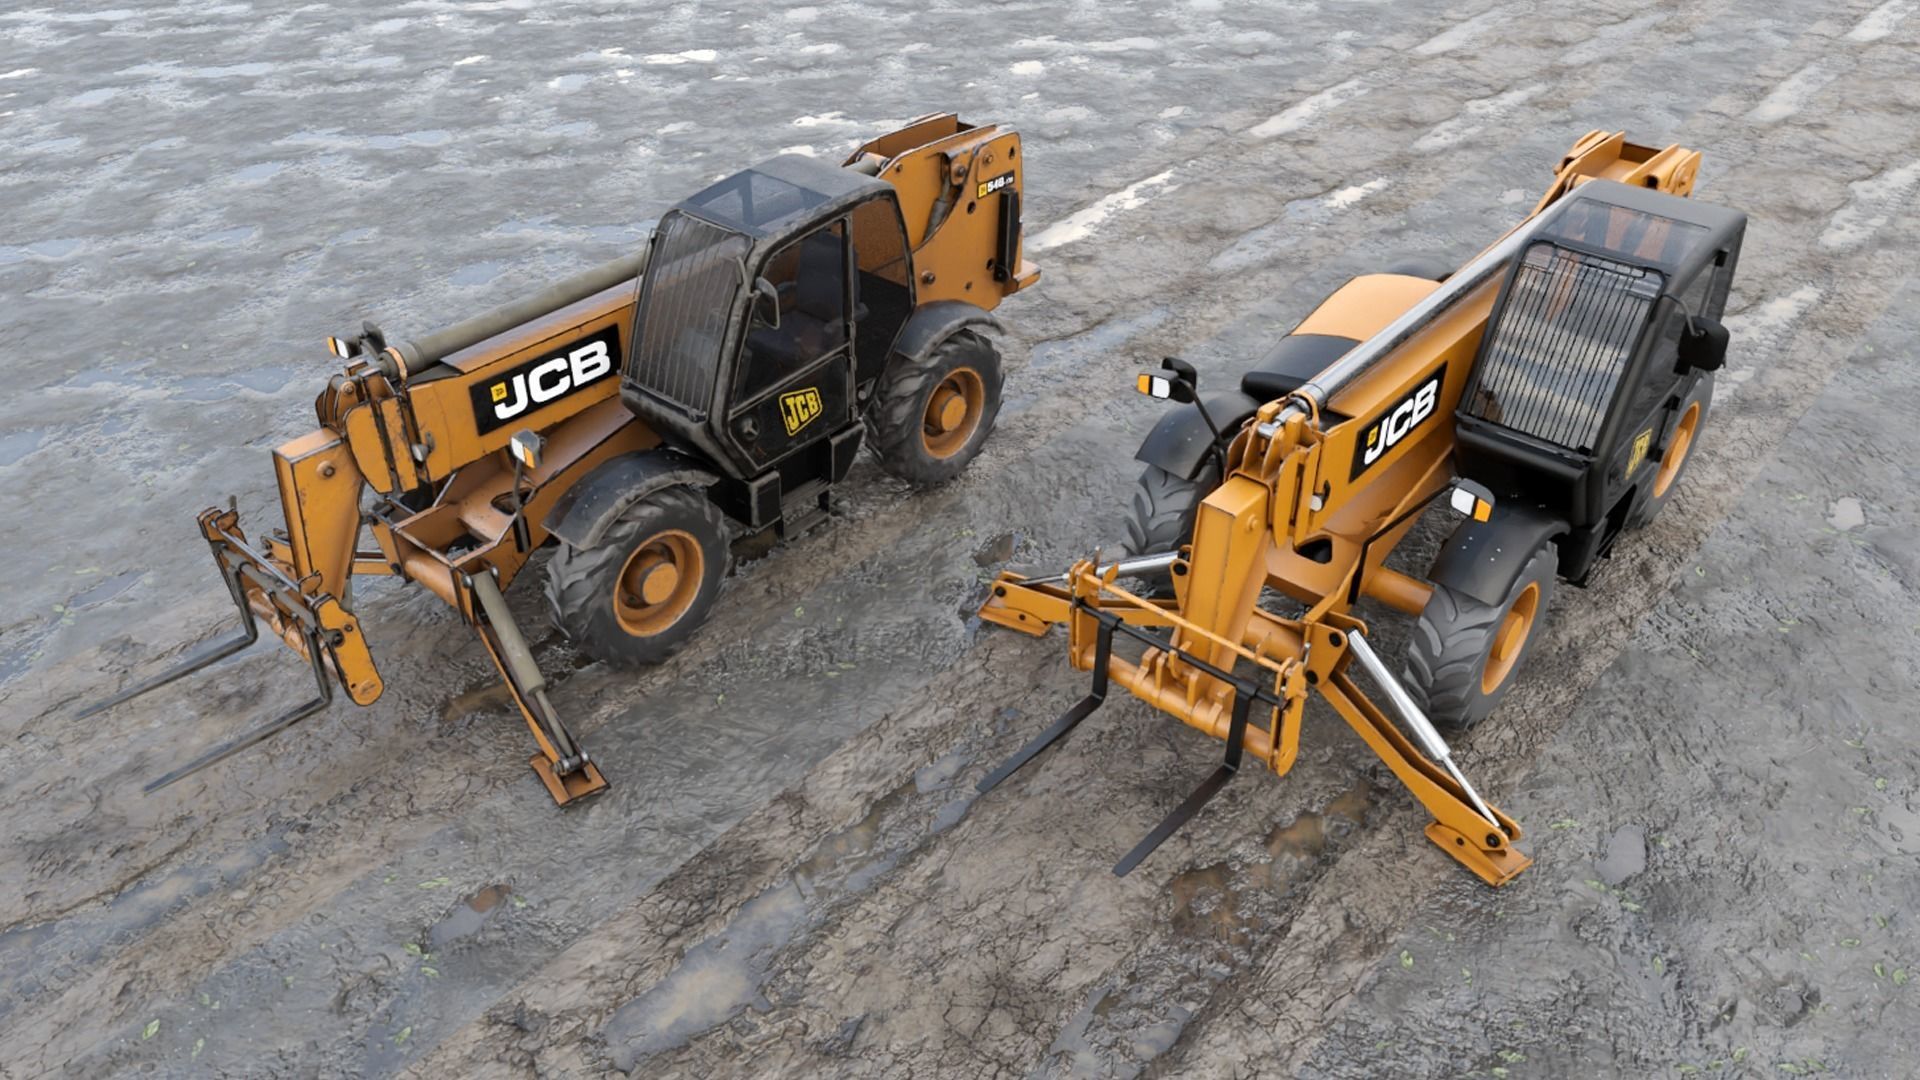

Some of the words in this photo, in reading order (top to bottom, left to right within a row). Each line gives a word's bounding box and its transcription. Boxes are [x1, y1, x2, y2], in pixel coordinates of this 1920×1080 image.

[495, 340, 611, 420] JCB
[785, 392, 819, 430] JCB
[1364, 379, 1438, 465] JCB
